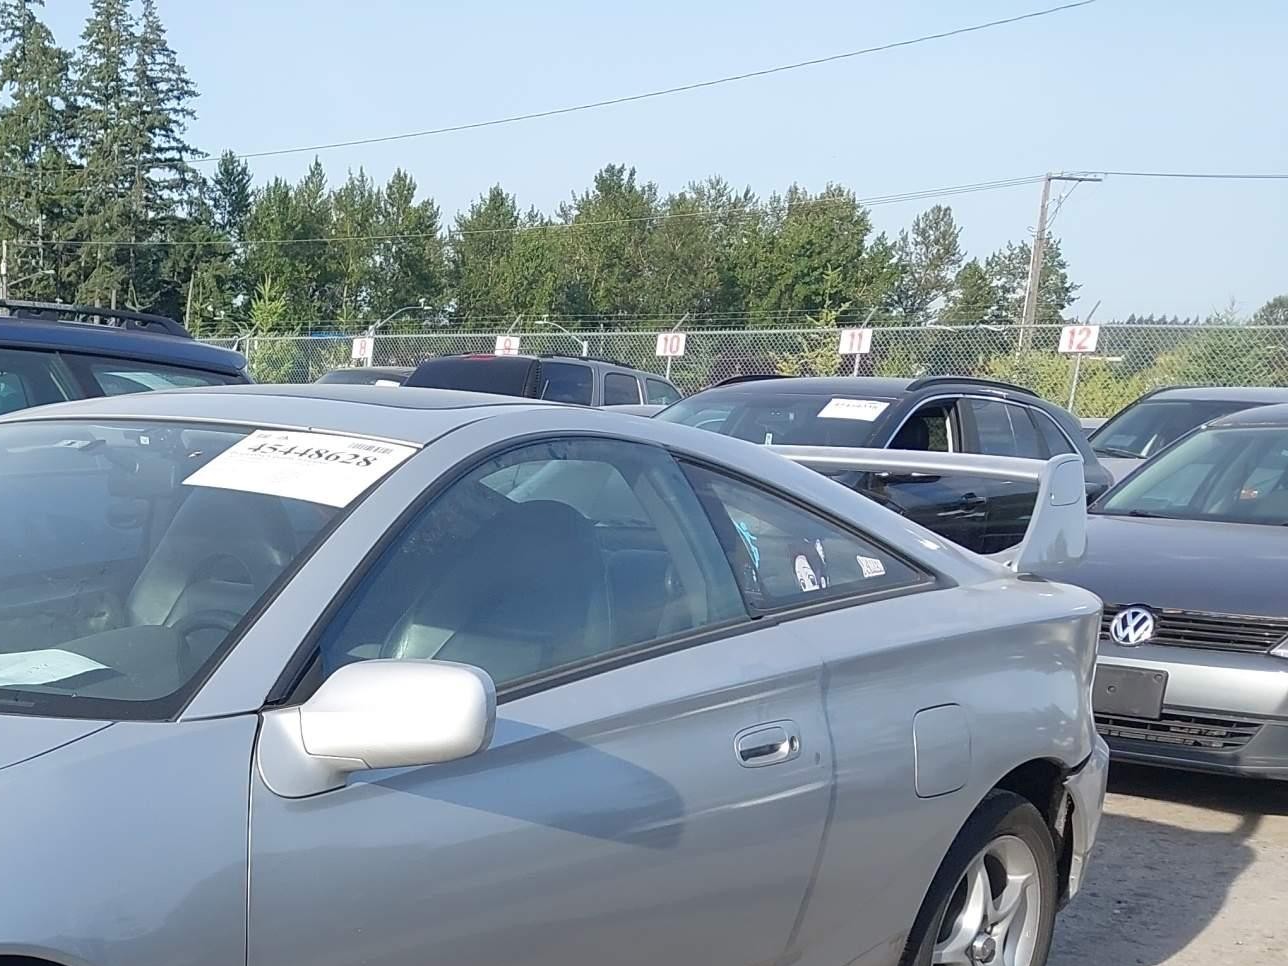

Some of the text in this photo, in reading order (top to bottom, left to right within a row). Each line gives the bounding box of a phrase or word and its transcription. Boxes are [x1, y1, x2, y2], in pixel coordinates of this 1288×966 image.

[359, 339, 367, 356] 8
[503, 337, 512, 355] 9
[662, 333, 680, 355] 10
[848, 331, 863, 351] 11
[1067, 327, 1092, 350] 12
[248, 442, 377, 467] 45448628
